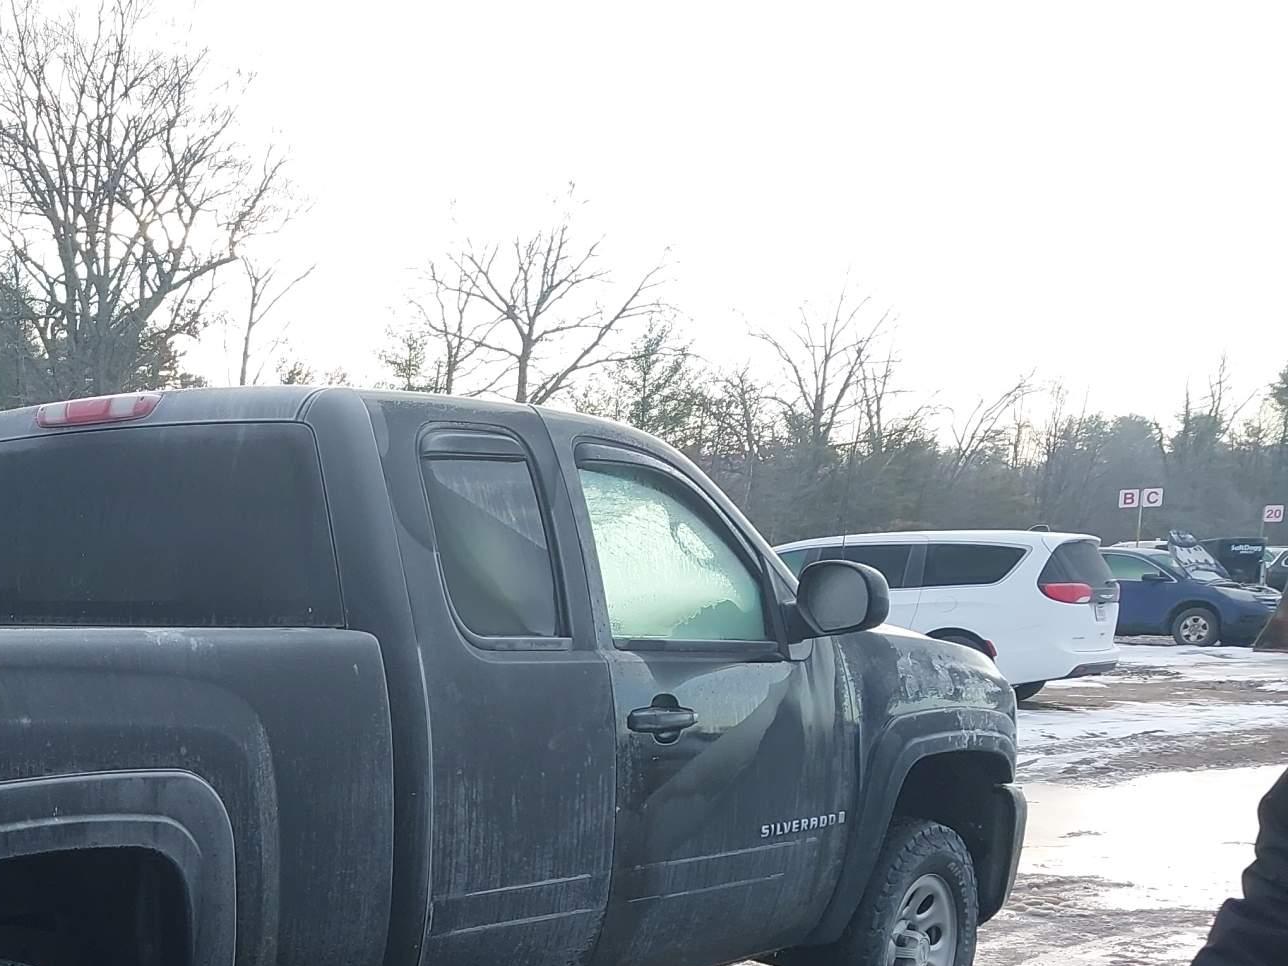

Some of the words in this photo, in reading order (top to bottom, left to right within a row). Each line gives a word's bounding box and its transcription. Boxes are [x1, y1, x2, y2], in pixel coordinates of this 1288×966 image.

[1123, 492, 1135, 505] B
[1146, 491, 1159, 504] C
[1266, 509, 1282, 519] 20
[760, 813, 836, 838] SILVERADO
